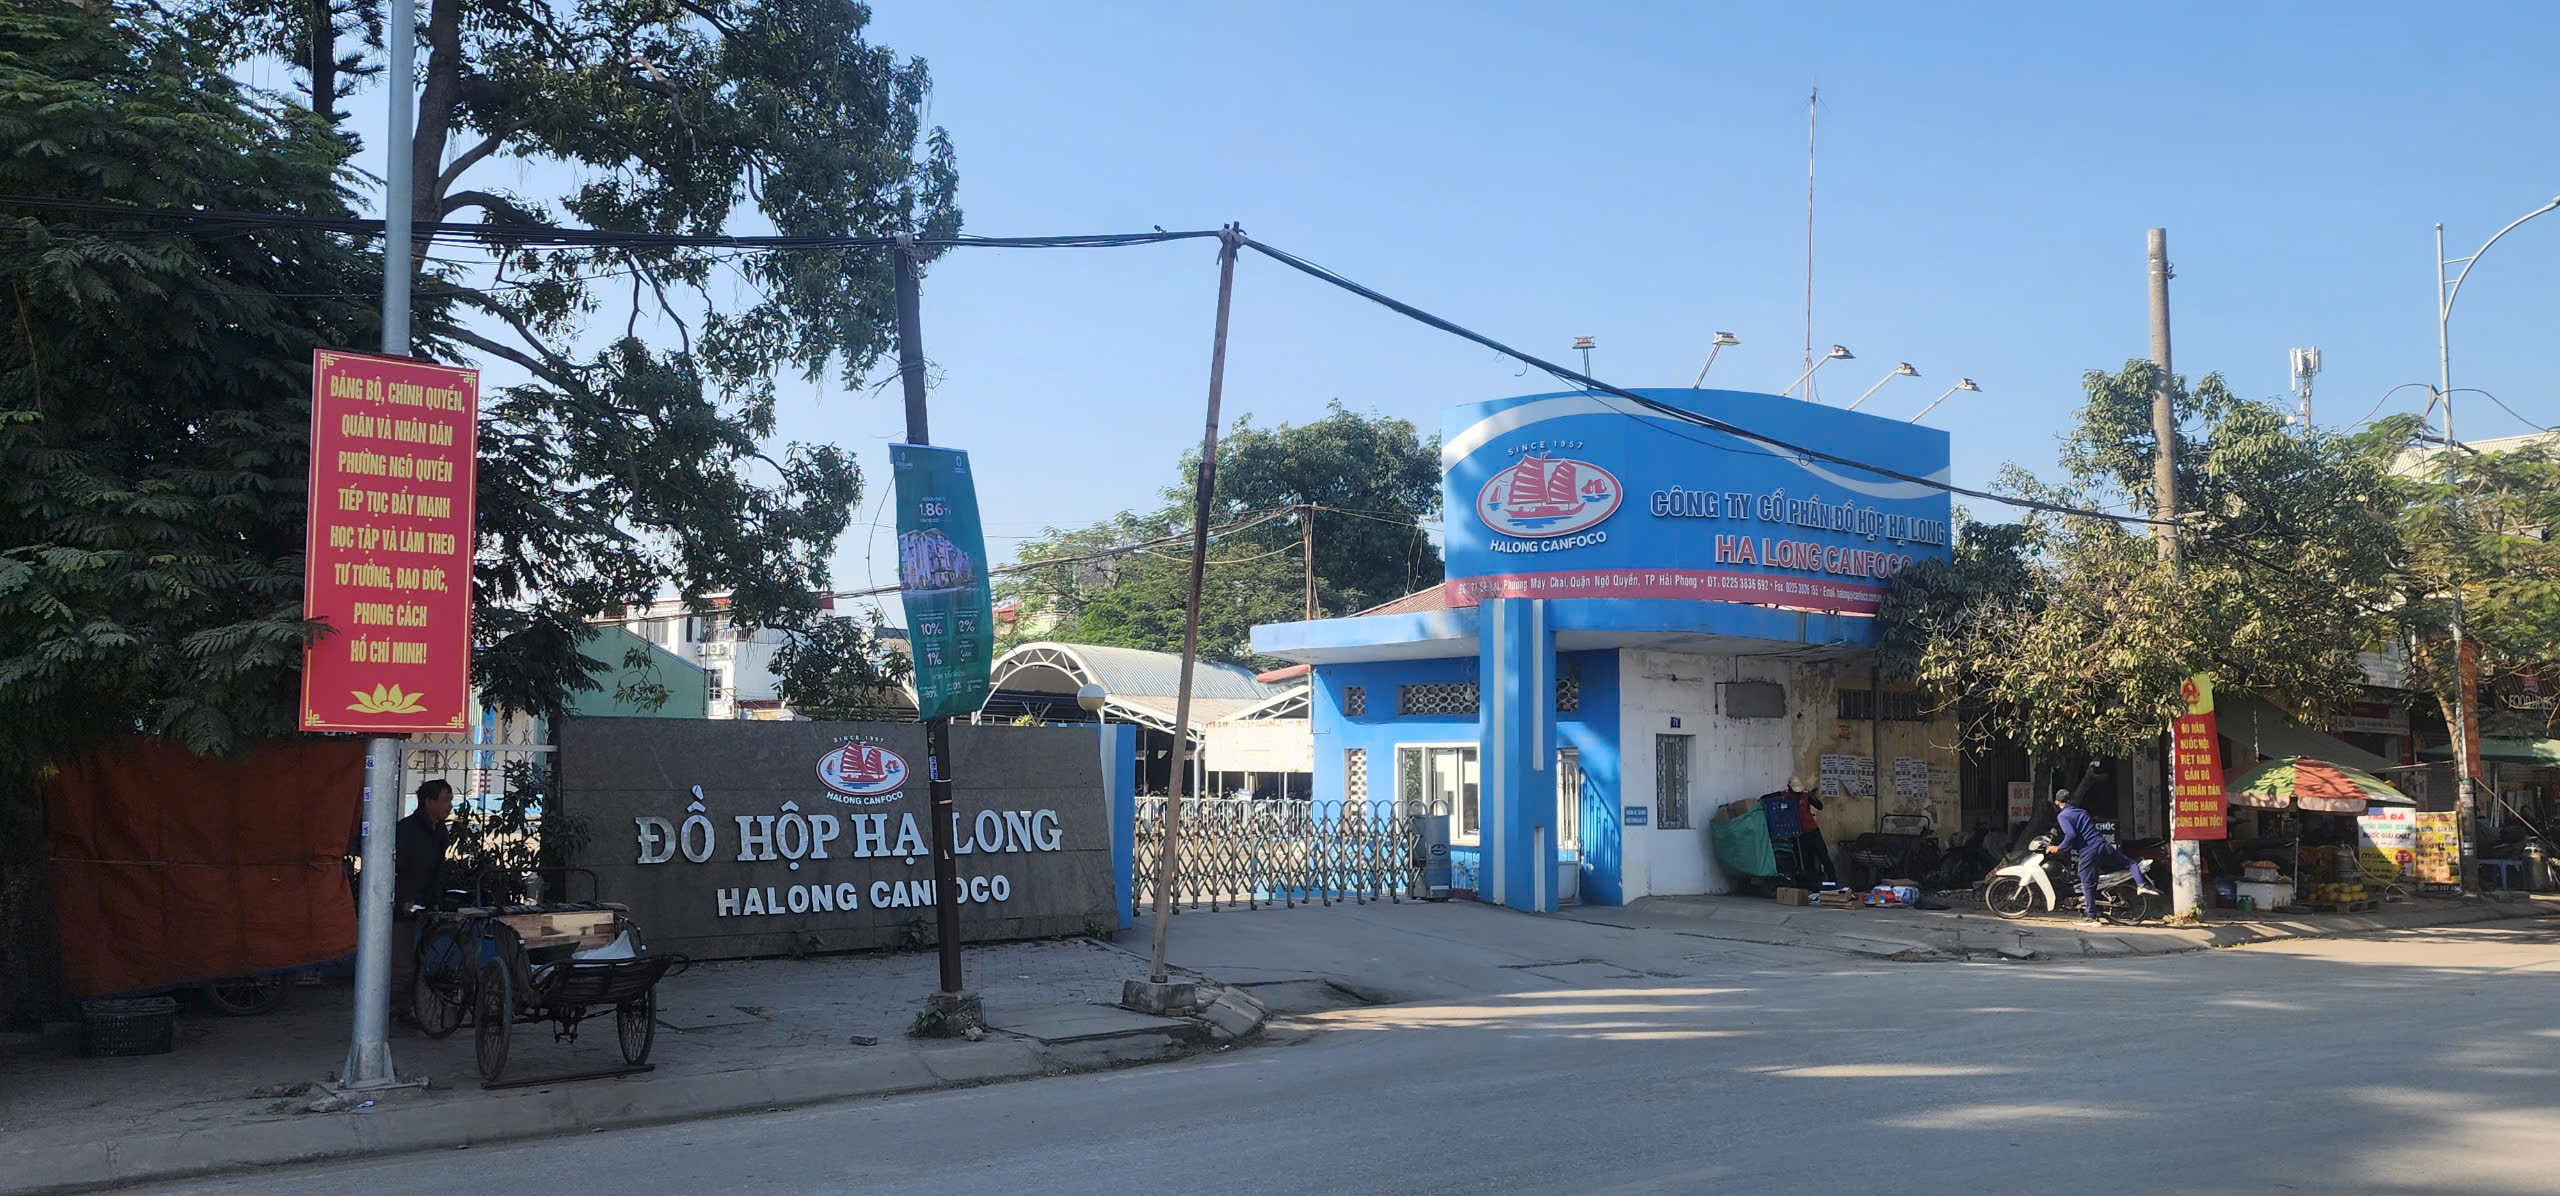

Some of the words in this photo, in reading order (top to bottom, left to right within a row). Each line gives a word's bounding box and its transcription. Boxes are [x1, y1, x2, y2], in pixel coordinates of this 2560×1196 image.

[330, 370, 363, 400] ĐẢNG
[366, 376, 384, 406] BỘ,
[388, 380, 423, 406] CHÍNH
[426, 384, 465, 414] QUYỀN,
[342, 411, 374, 438] QUÂN
[377, 414, 392, 440] VÀ
[394, 417, 426, 444] NHÂN
[430, 420, 452, 446] DÂN
[1508, 440, 1545, 456] SINCE
[1554, 440, 1584, 449] 1957
[338, 448, 386, 476] PHƯỜNG
[389, 453, 413, 478] NGÔ
[416, 454, 452, 482] QUYỀN
[338, 483, 364, 511] TIẾP
[366, 491, 388, 518] TỤC
[392, 486, 414, 516] ĐẨY
[416, 496, 450, 522] MẠNH
[920, 503, 944, 516] 1.86
[1651, 486, 1720, 518] CÔNG
[1725, 492, 1752, 520] TY
[1757, 488, 1784, 523] CỔ
[1786, 494, 1830, 528] PHẦN
[1832, 500, 1855, 532] ĐỒ
[1856, 507, 1884, 541] HỘP
[1886, 514, 1906, 546] HẠ
[1908, 517, 1945, 546] LONG
[330, 525, 354, 552] HỌC
[358, 524, 380, 554] TẬP
[382, 526, 397, 550] VÀ
[400, 527, 424, 553] LÀM
[428, 532, 455, 555] THEO
[1490, 540, 1538, 554] HALONG
[1541, 531, 1606, 552] CANFOCO
[1715, 534, 1758, 564] HA
[1761, 538, 1822, 572] LONG
[335, 562, 351, 585] TƯ
[352, 558, 394, 590] TƯỞNG,
[396, 568, 420, 594] ĐẠO
[422, 565, 448, 594] ĐỨC,
[1531, 578, 1545, 590] Máy
[1570, 576, 1590, 588] Quận
[1594, 576, 1610, 588] Ngô
[1646, 574, 1655, 585] TP
[1660, 574, 1672, 586] Hải
[1722, 576, 1738, 588] 0225
[1758, 580, 1768, 590] 692
[354, 602, 394, 626] PHONG
[396, 601, 428, 627] CÁCH
[921, 623, 942, 635] 10%
[959, 620, 974, 632] 2%
[350, 634, 367, 662] HỒ
[370, 638, 390, 662] CHÍ
[393, 642, 427, 664] MINH!
[928, 652, 942, 665] 1%
[834, 735, 860, 743] SINCE
[2196, 754, 2212, 764] NAM
[826, 792, 862, 804] HALONG
[864, 791, 904, 804] CANFOCO
[635, 784, 716, 864] ĐỒ
[735, 800, 840, 870] HỘP
[851, 812, 928, 866] HẠ
[952, 808, 1062, 854] LONG
[717, 882, 858, 917] HALONG
